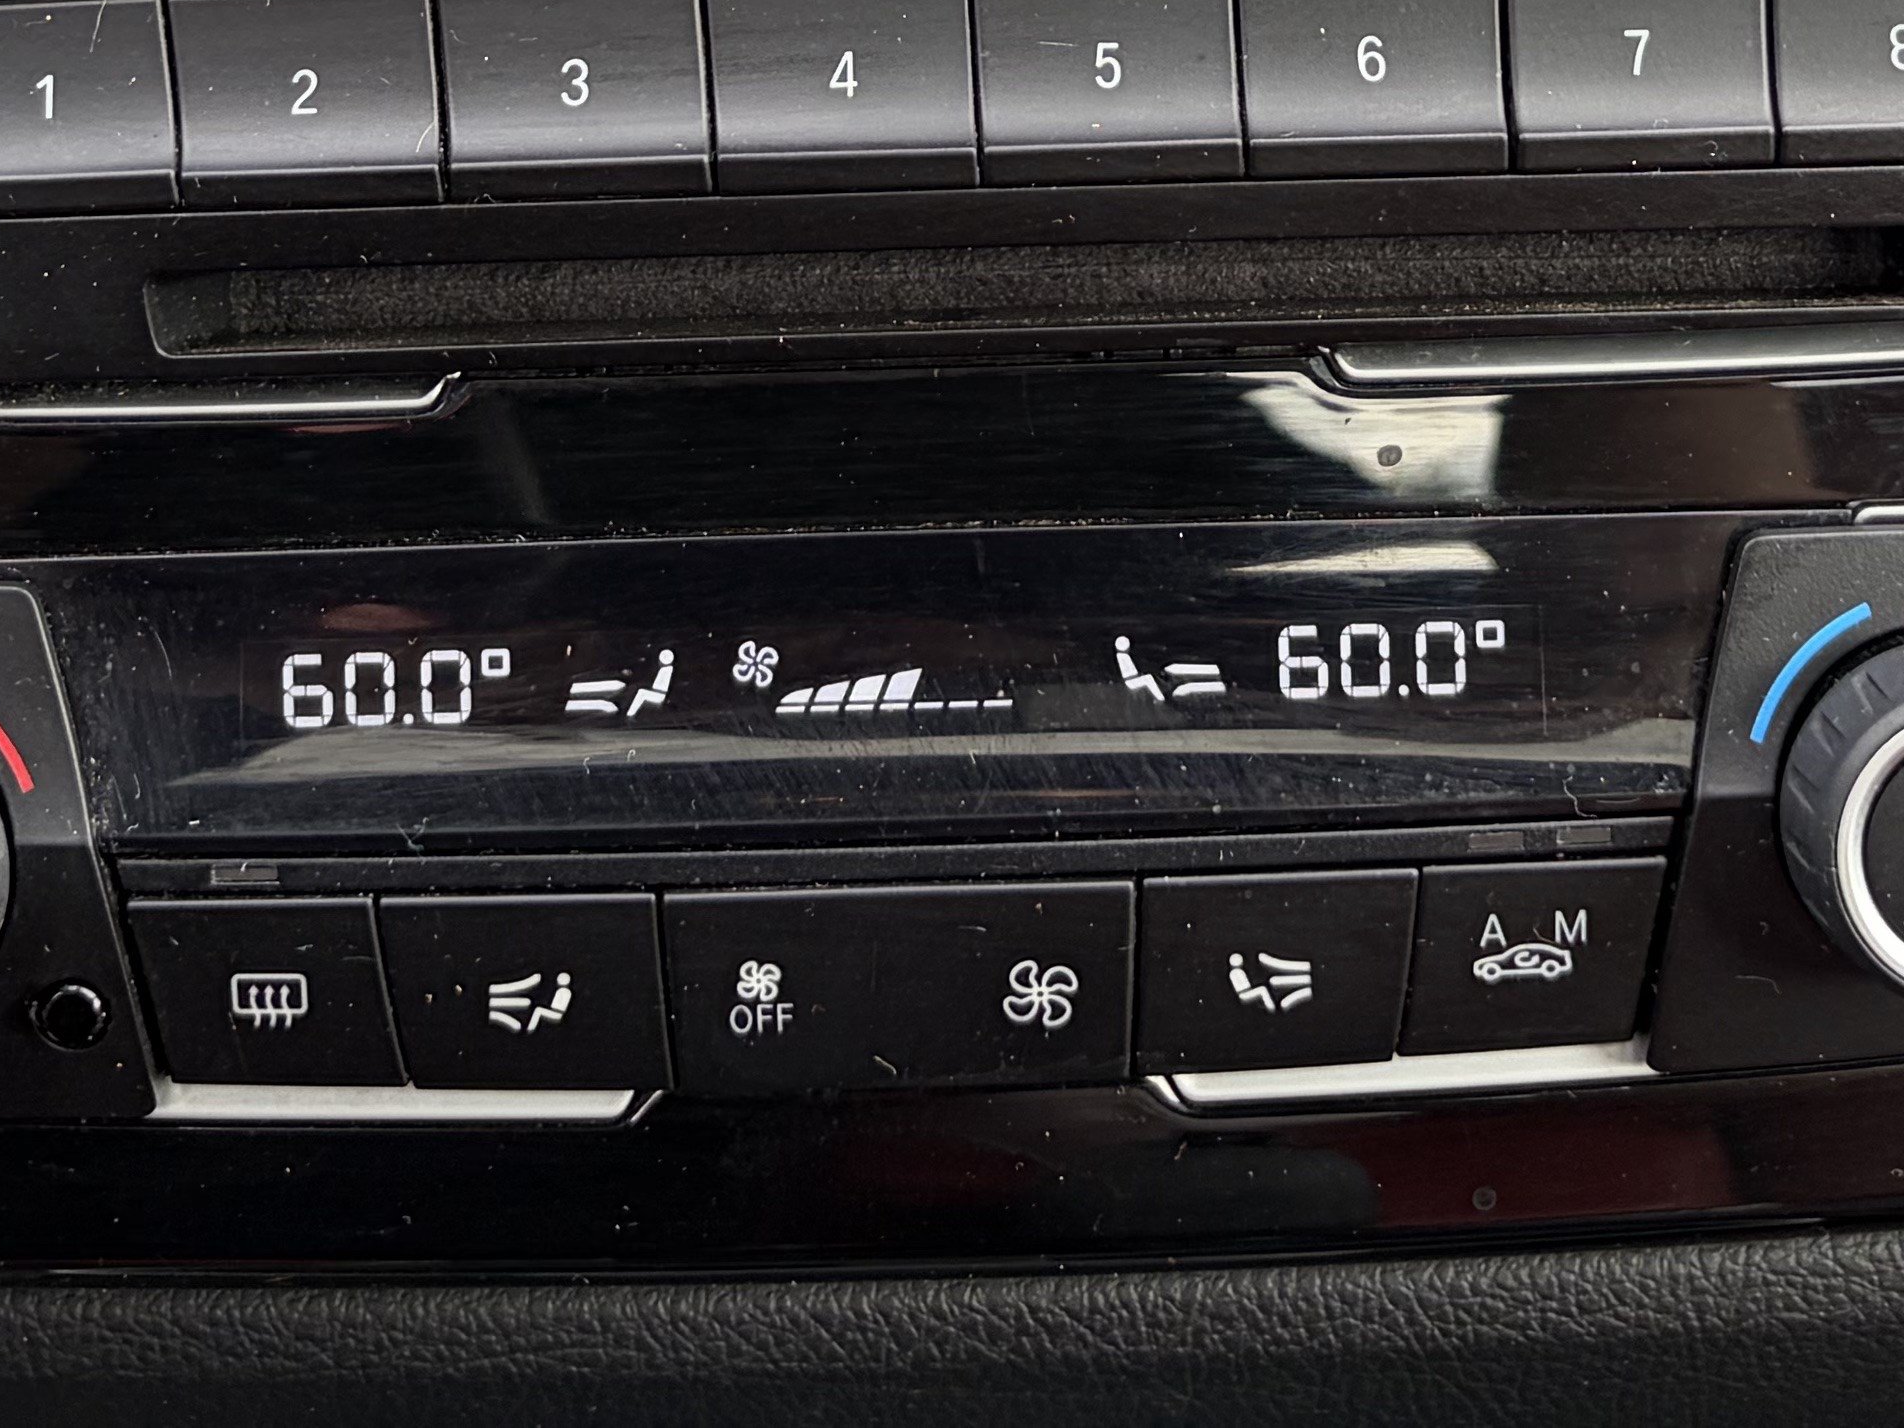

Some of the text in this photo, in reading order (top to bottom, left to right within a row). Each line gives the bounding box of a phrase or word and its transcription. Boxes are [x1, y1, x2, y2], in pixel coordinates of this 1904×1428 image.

[830, 52, 856, 97] 4
[1094, 43, 1122, 87] 5
[1356, 37, 1386, 82] 6
[1624, 30, 1650, 75] 7
[36, 76, 57, 118] 1
[291, 69, 319, 115] 2
[562, 59, 589, 106] 3
[1480, 910, 1587, 946] A M
[730, 1003, 794, 1035] OFF
